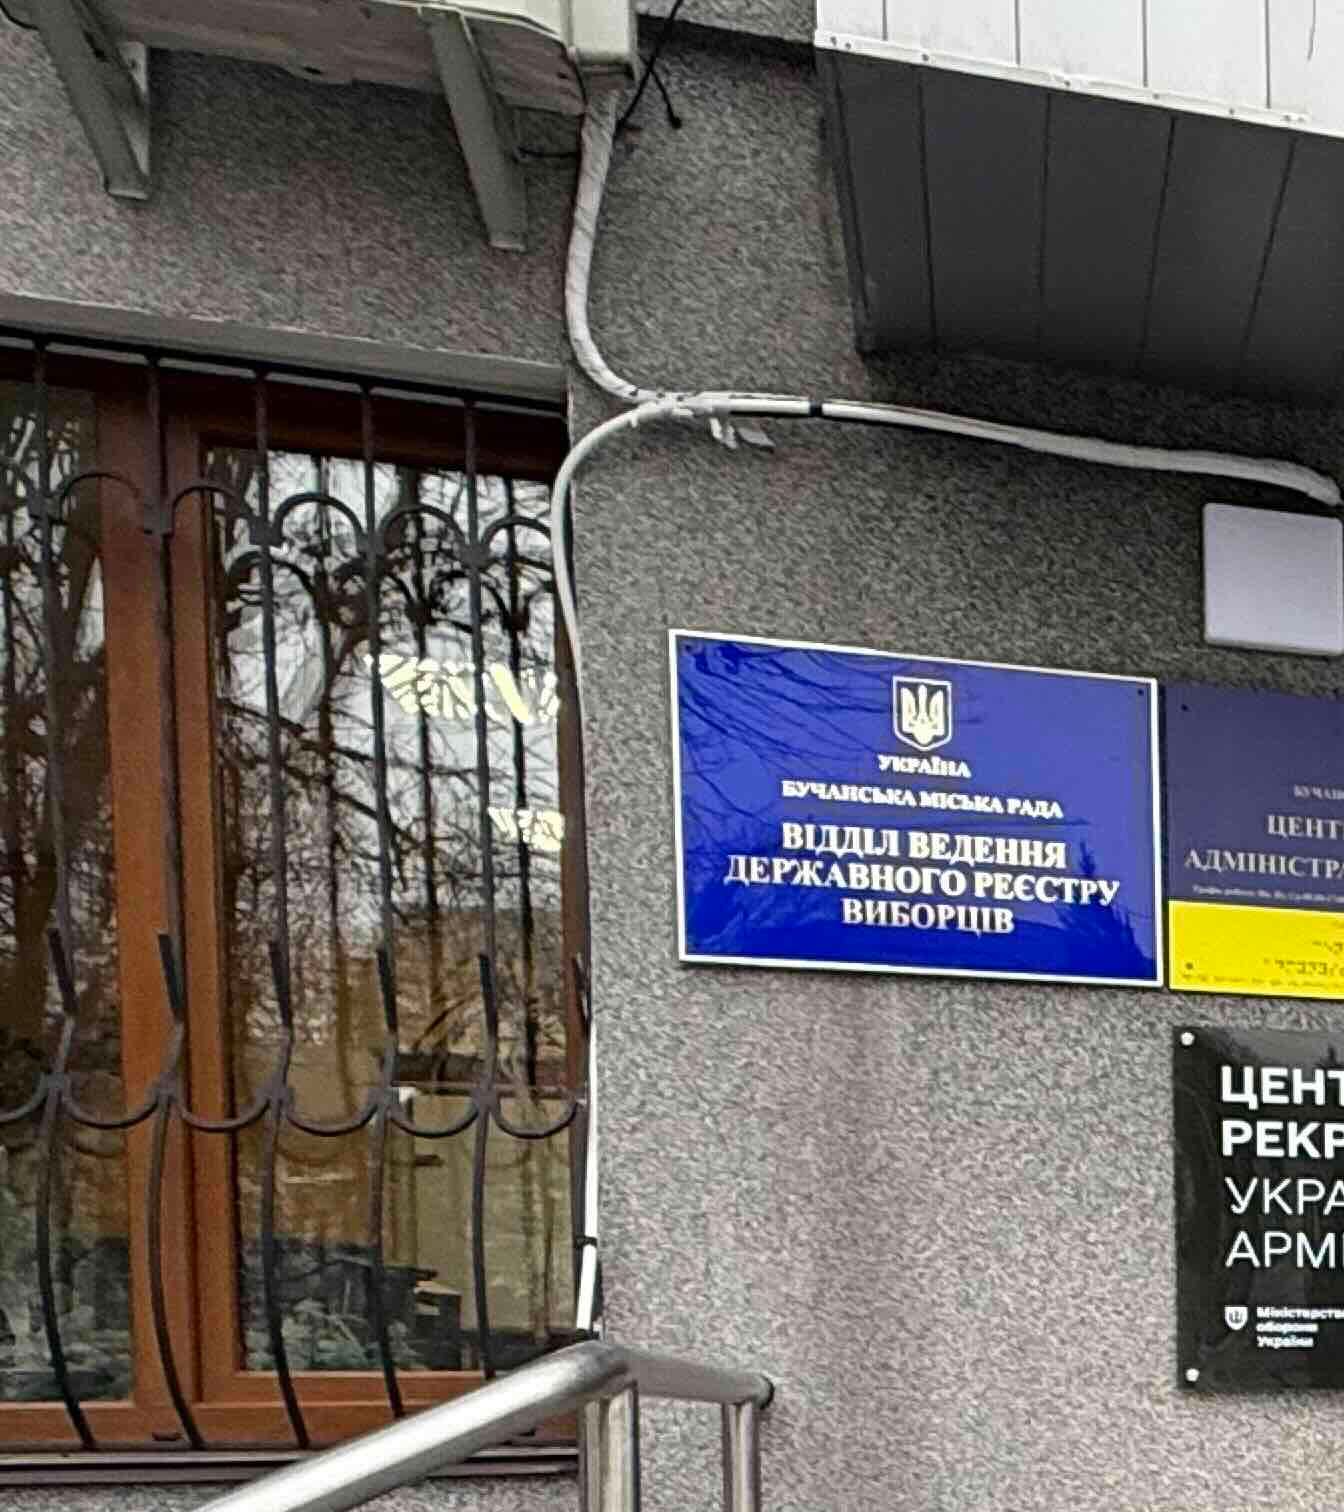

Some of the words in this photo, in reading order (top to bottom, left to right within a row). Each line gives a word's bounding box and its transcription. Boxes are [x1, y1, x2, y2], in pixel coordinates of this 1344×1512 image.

[878, 754, 972, 779] УКРАЇНА
[782, 780, 917, 807] БУЧАНСЬКА
[919, 790, 1004, 815] МІСЬКА
[1007, 798, 1064, 819] РАДА
[782, 823, 899, 857] ВІДДІЛ
[908, 832, 1066, 869] ВЕДЕННЯ
[724, 855, 965, 897] ДЕРЖАВНОГО
[975, 872, 1120, 907] РЕЄСТРУ
[842, 899, 1015, 936] ВИБОРЦІВ
